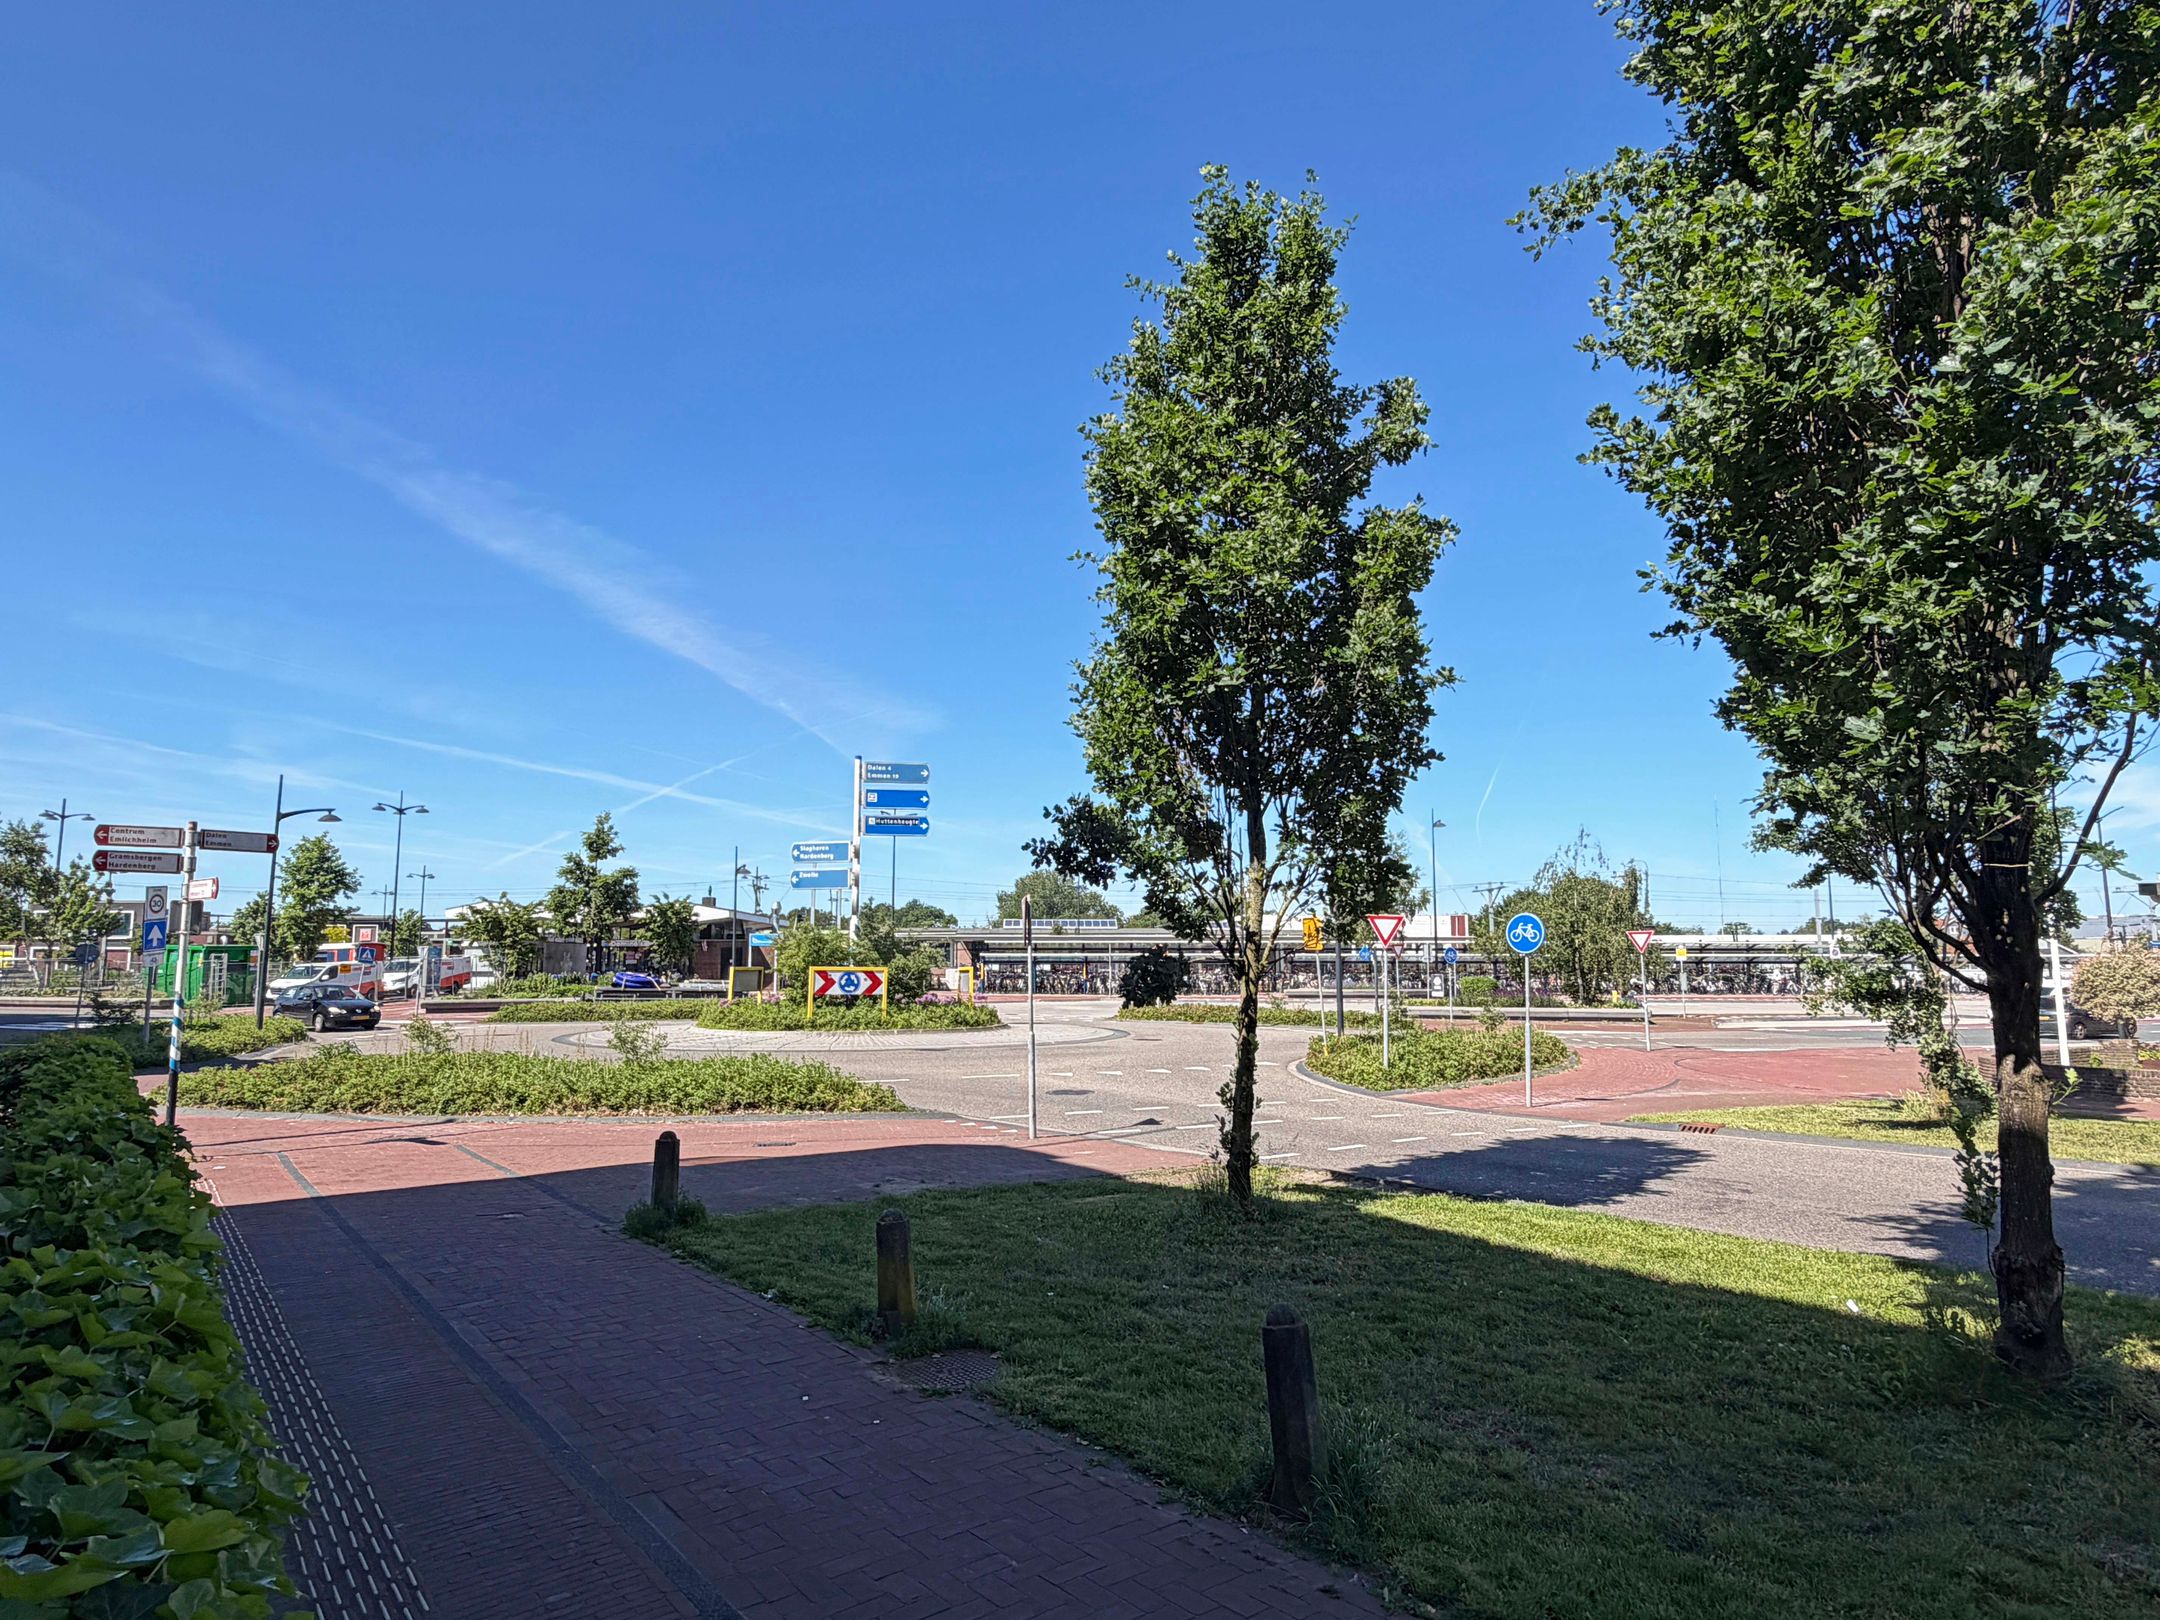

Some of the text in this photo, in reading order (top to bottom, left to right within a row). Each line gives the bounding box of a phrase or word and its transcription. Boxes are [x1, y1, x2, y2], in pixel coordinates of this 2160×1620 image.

[110, 827, 145, 835] Centrum
[109, 853, 162, 862] Gramsbergen
[108, 862, 156, 870] Hardenberg
[152, 900, 162, 908] 30
